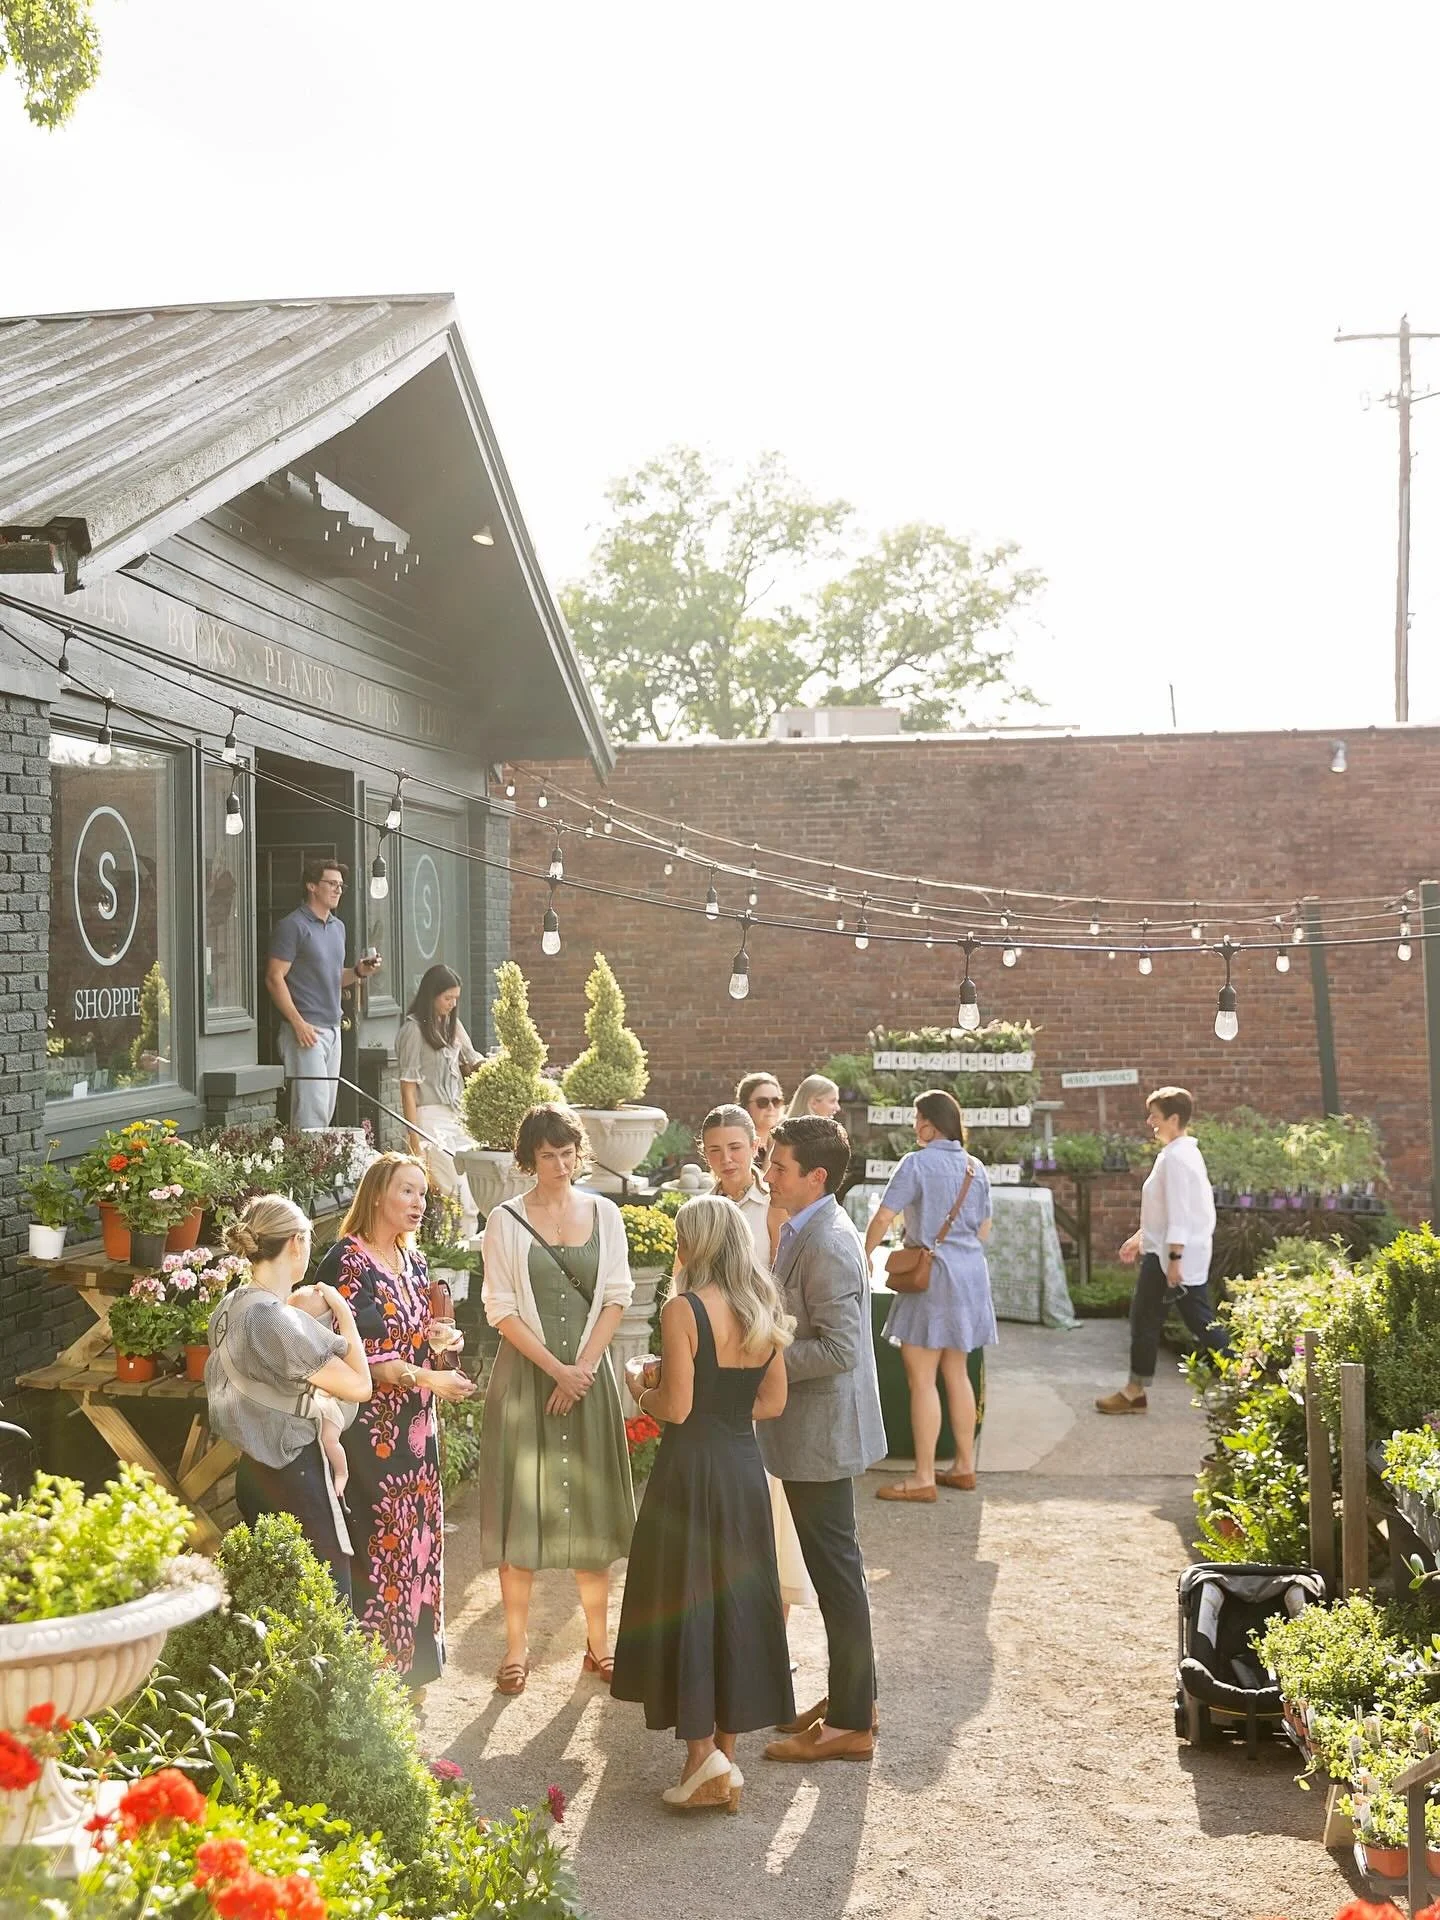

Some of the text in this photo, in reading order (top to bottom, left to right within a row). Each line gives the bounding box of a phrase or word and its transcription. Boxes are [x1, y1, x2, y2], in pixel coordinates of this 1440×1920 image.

[167, 606, 237, 669] BOOKS
[264, 645, 335, 704] PLANTS
[357, 681, 400, 726] GIFTS
[98, 851, 117, 920] S
[423, 884, 432, 929] S
[74, 986, 141, 1021] SHOPPE
